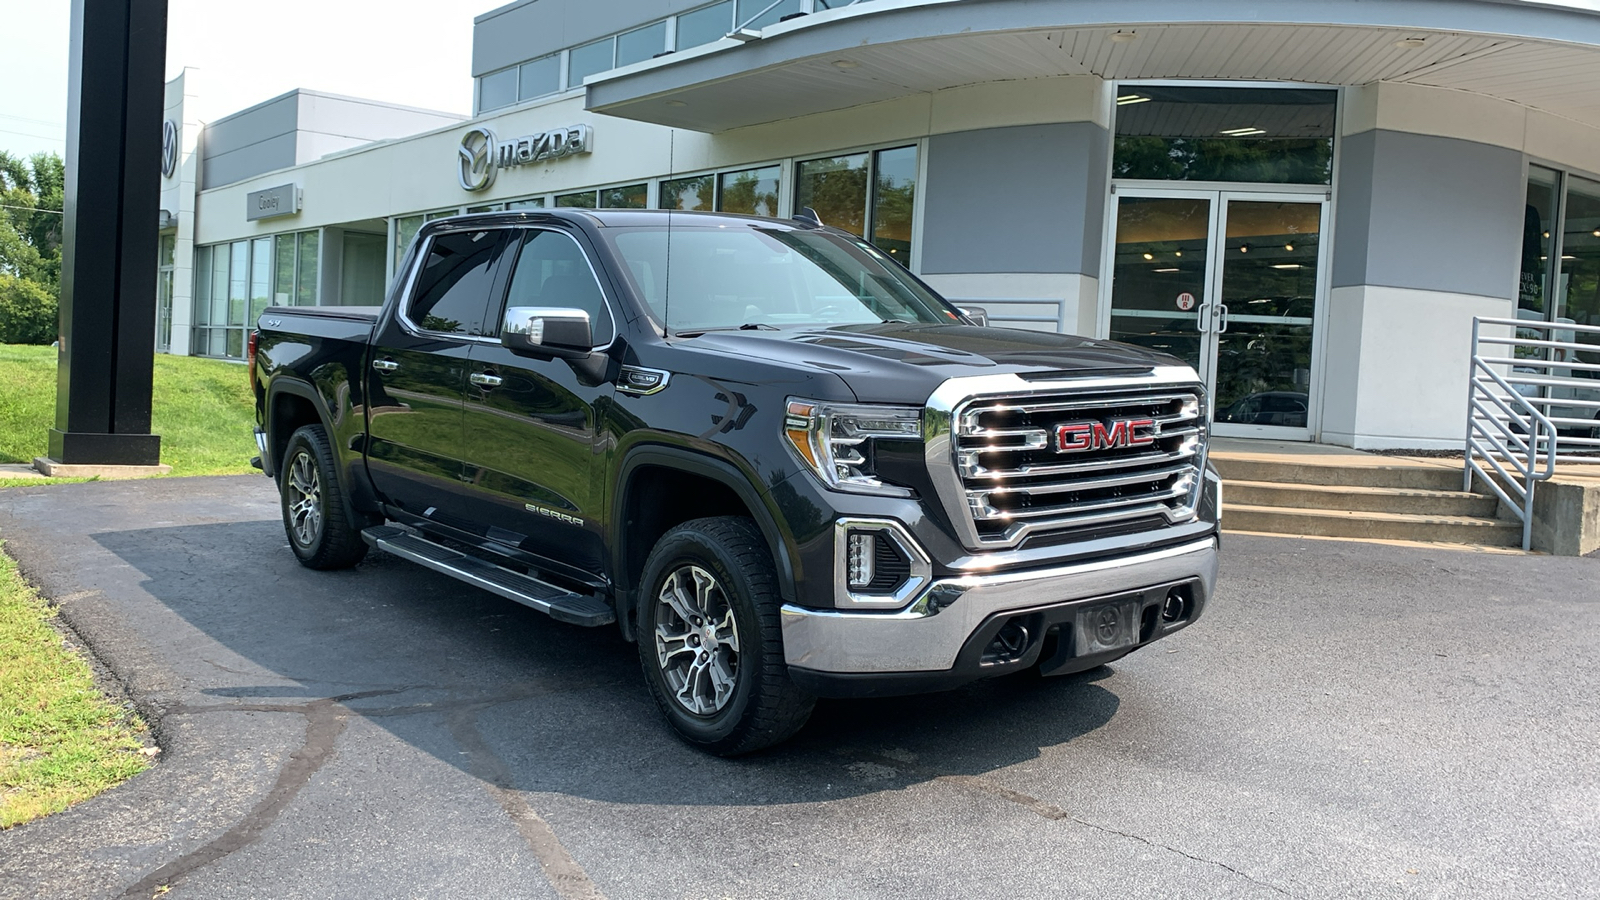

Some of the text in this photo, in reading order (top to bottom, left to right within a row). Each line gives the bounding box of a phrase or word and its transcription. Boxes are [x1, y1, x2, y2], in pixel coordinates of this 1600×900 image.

[258, 191, 280, 212] Cooley
[1056, 419, 1154, 453] GMC
[525, 503, 584, 527] SIERRA
